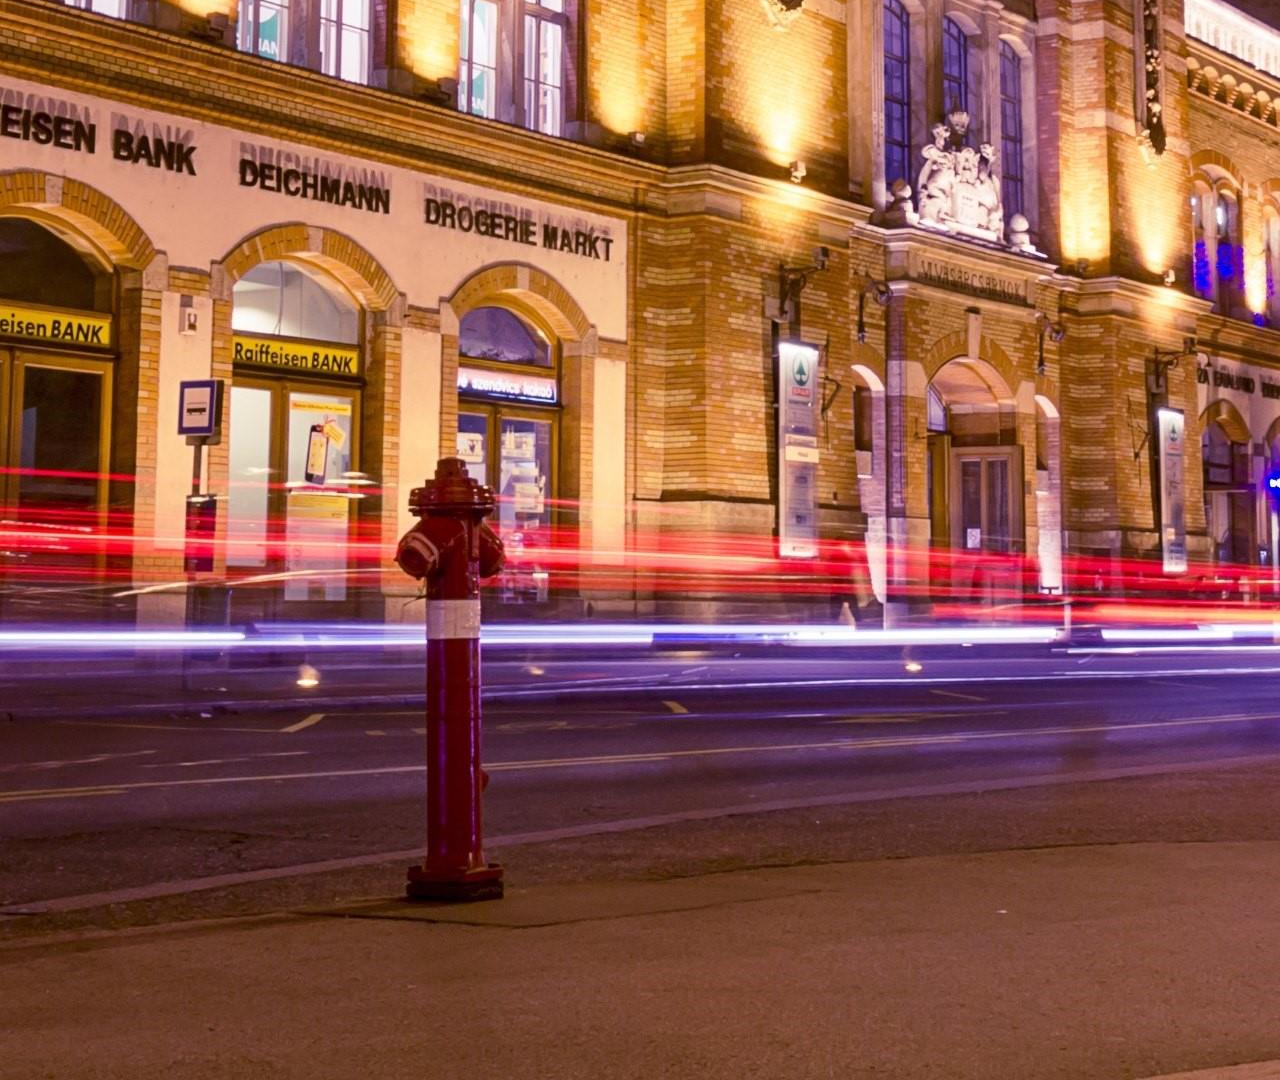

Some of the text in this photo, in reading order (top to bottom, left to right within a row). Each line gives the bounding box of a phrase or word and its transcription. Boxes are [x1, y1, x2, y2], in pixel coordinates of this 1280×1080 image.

[112, 128, 197, 176] BANK
[239, 158, 391, 214] DEICHMANN
[423, 197, 614, 262] DROGERIE MARKT
[50, 319, 104, 345] BANK
[234, 342, 353, 374] Raiffeisen BANK
